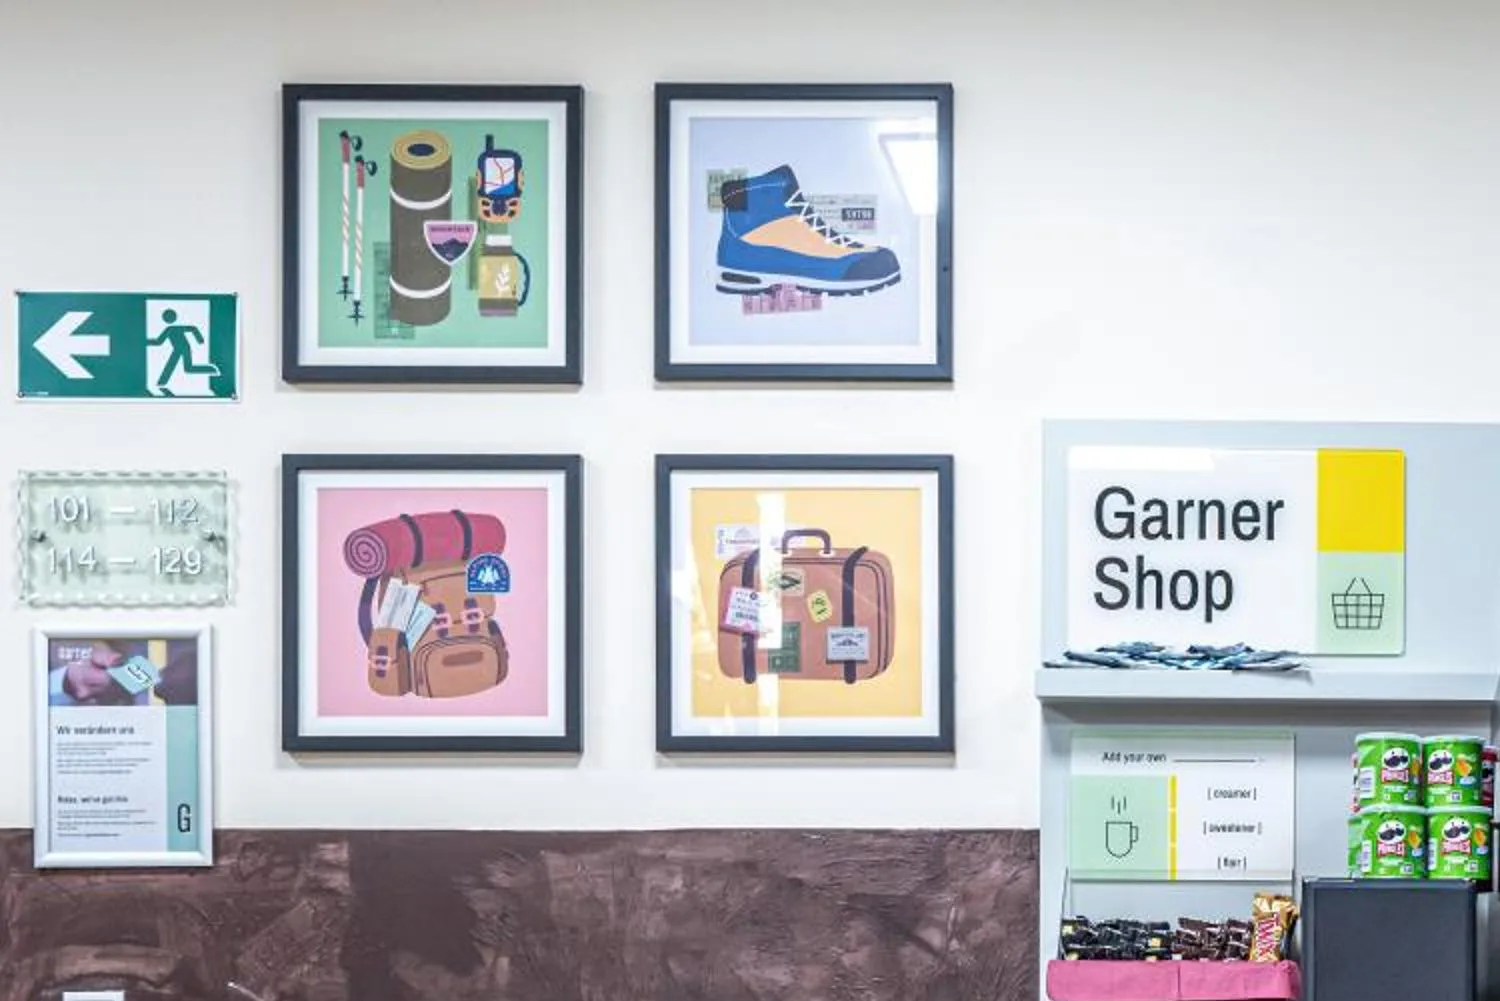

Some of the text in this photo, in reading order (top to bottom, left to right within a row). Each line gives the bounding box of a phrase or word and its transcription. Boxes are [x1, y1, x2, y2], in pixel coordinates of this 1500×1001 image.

[51, 495, 91, 523] 101
[153, 497, 200, 523] 112
[1094, 486, 1285, 541] Garner
[50, 546, 97, 574] 114
[153, 547, 203, 575] 129
[1093, 554, 1234, 623] Shop
[1102, 751, 1167, 763] Add your own
[177, 803, 191, 833] G
